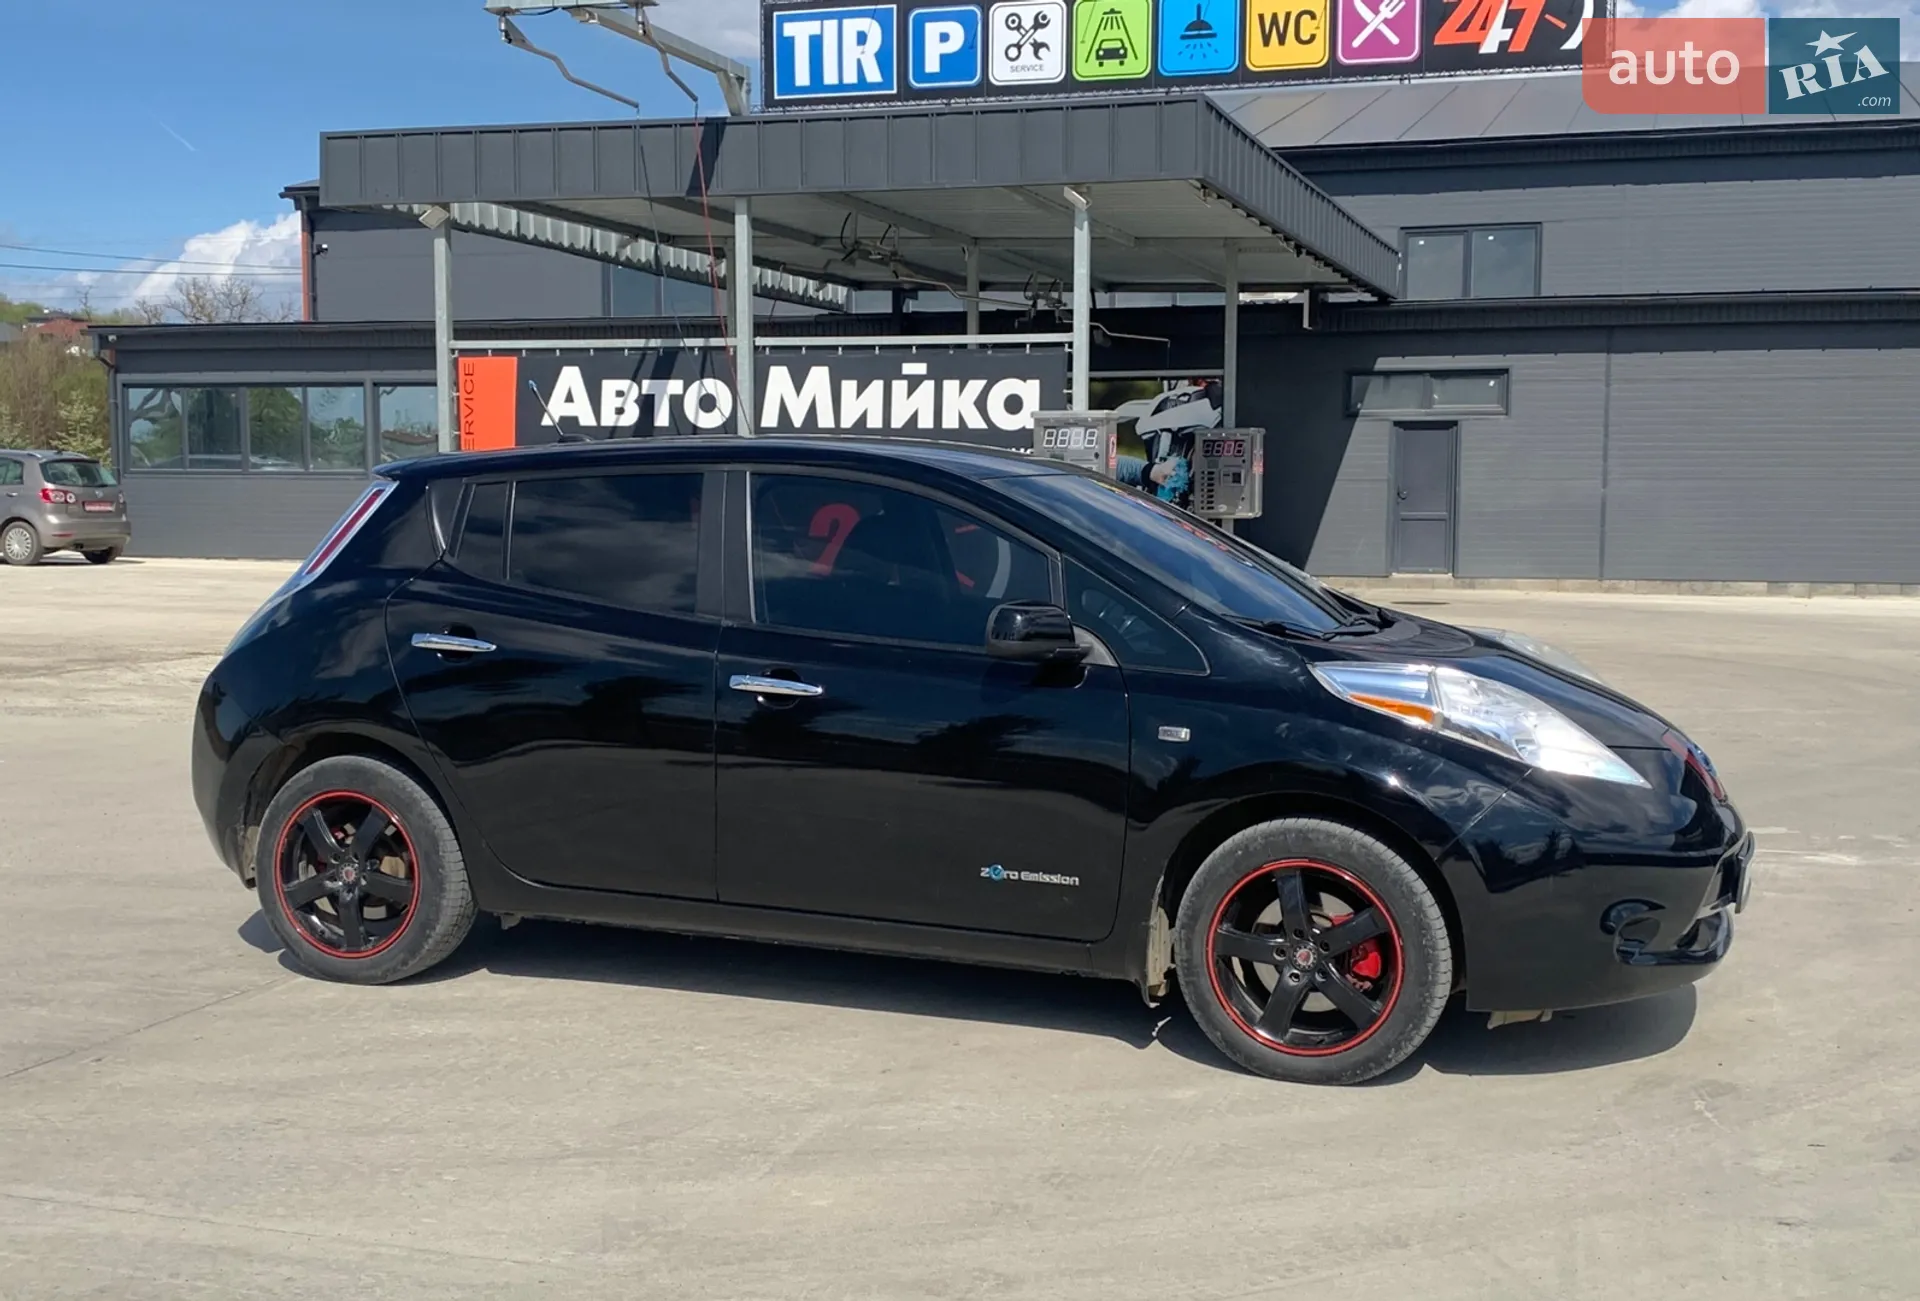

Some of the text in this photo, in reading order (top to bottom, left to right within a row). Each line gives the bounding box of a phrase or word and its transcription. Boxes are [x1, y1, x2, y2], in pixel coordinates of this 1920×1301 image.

[783, 16, 884, 88] TIR
[924, 21, 965, 74] P
[1258, 10, 1317, 48] WC
[1010, 64, 1044, 73] SERVICE
[463, 362, 475, 450] ERVICE
[760, 363, 1041, 430] Мийка
